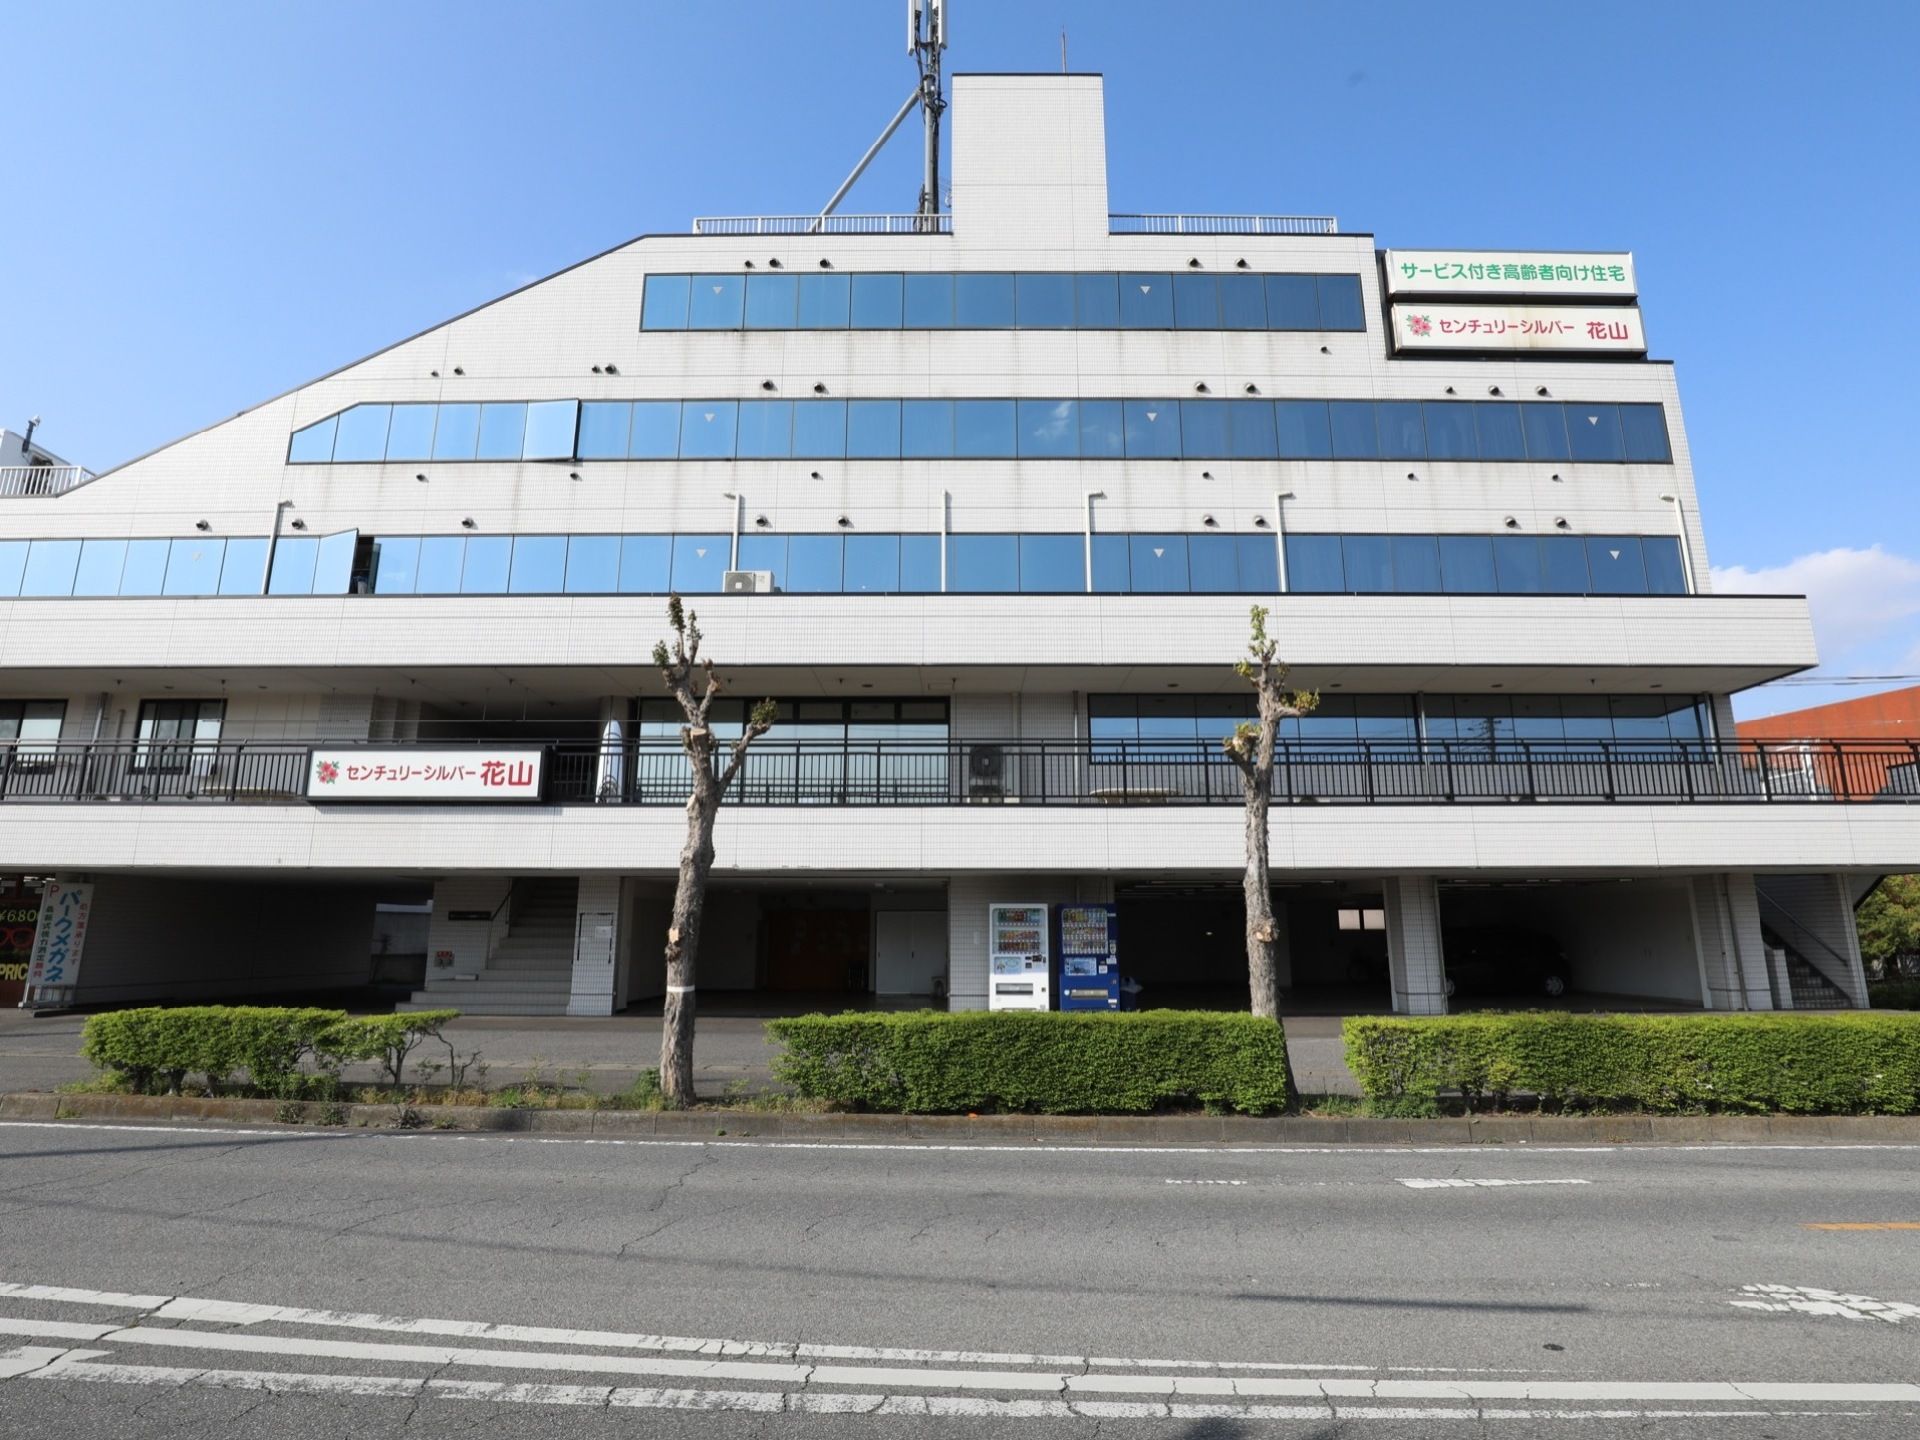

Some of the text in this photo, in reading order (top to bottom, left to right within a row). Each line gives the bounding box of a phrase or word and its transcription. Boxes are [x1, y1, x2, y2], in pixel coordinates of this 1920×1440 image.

[1400, 262, 1626, 282] サービス付き高齢者向け住宅
[1439, 318, 1629, 340] センチュリーシルバー 花山
[346, 760, 533, 786] センチュリーシルバー 花山
[44, 889, 83, 982] パークメガネ
